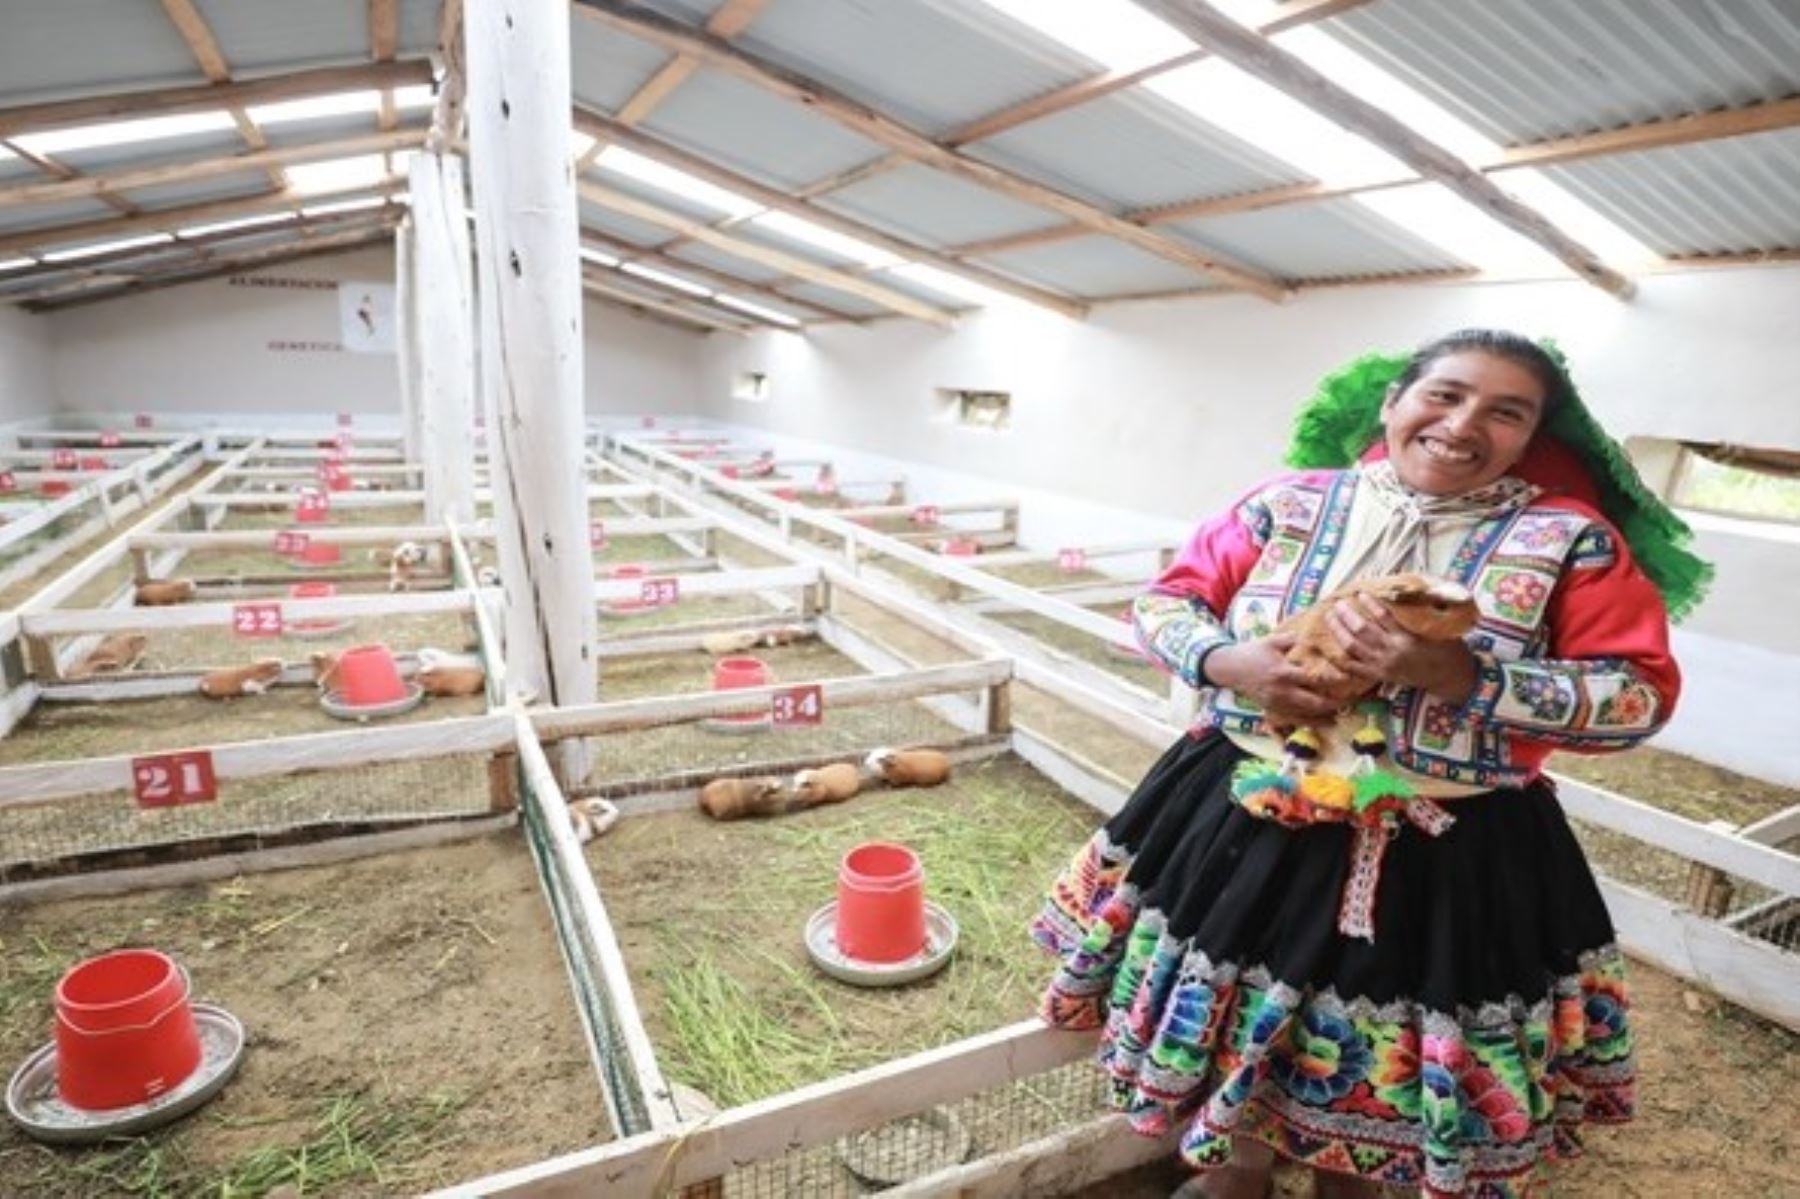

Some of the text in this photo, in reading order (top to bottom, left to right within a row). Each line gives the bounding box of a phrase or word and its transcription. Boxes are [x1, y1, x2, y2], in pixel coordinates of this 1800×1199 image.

[642, 582, 676, 602] 33
[236, 608, 280, 632] 22
[774, 691, 818, 720] 34
[136, 761, 205, 799] 21
